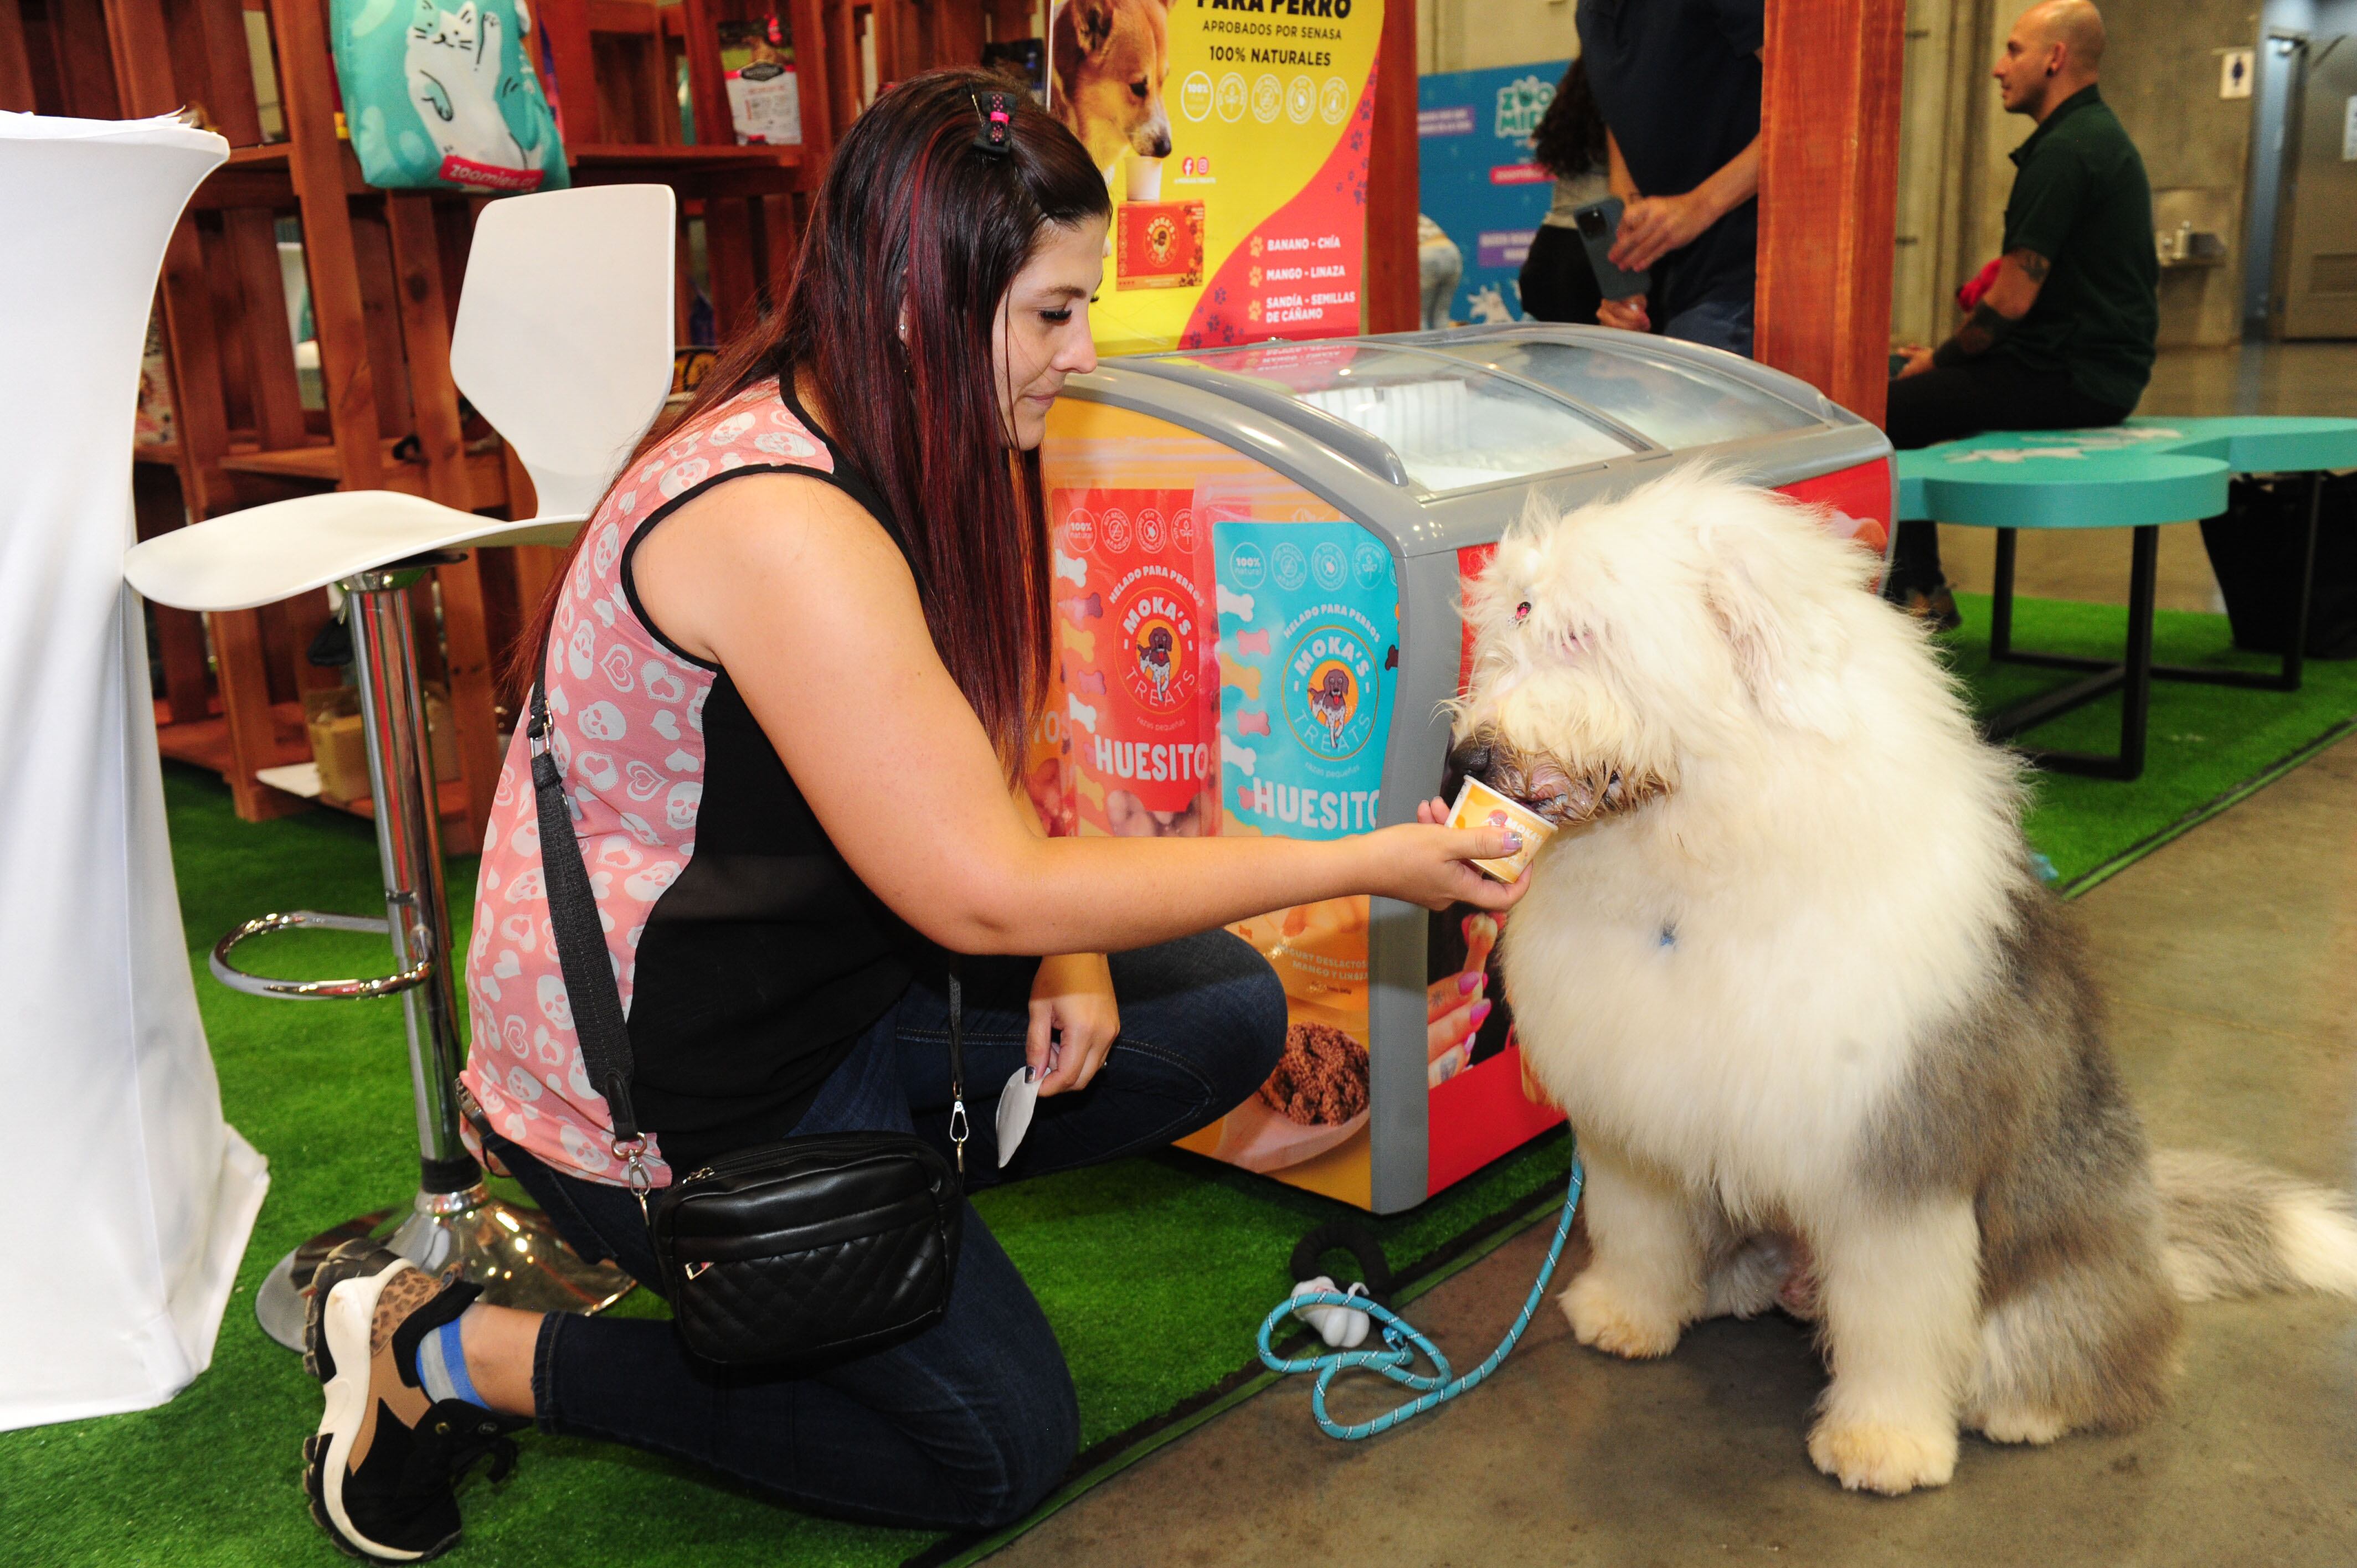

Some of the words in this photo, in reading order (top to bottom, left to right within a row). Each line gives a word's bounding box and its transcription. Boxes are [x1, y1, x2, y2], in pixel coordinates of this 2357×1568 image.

[1270, 0, 1351, 19] PERRO
[1202, 20, 1272, 36] APROBADOS
[1275, 24, 1297, 37] POR
[1301, 27, 1342, 40] SENASA
[1210, 45, 1246, 61] 100%
[1250, 48, 1331, 66] NATURALES
[1267, 238, 1309, 251] BANANO
[1318, 234, 1341, 249] CHÍA
[1266, 267, 1303, 281] MANGO
[1310, 265, 1345, 278] LINAZA
[1266, 293, 1303, 309] SANDÍA
[1311, 291, 1356, 305] SEMILLAS
[1266, 311, 1279, 323] DE
[1281, 307, 1323, 322] CÁÑAMO
[1071, 522, 1092, 532] 100%
[1236, 557, 1260, 568] 100%
[1109, 568, 1141, 604] HELADO
[1143, 565, 1169, 577] PARA
[1170, 570, 1205, 607] PERROS
[1123, 596, 1192, 636] MOKA'S
[1284, 606, 1319, 638] HELADO
[1321, 604, 1348, 616] PARA
[1349, 608, 1381, 643] PERROS
[1294, 636, 1370, 677] MOKA'S
[1126, 666, 1196, 707] TREATS
[1295, 709, 1371, 753] TREATS
